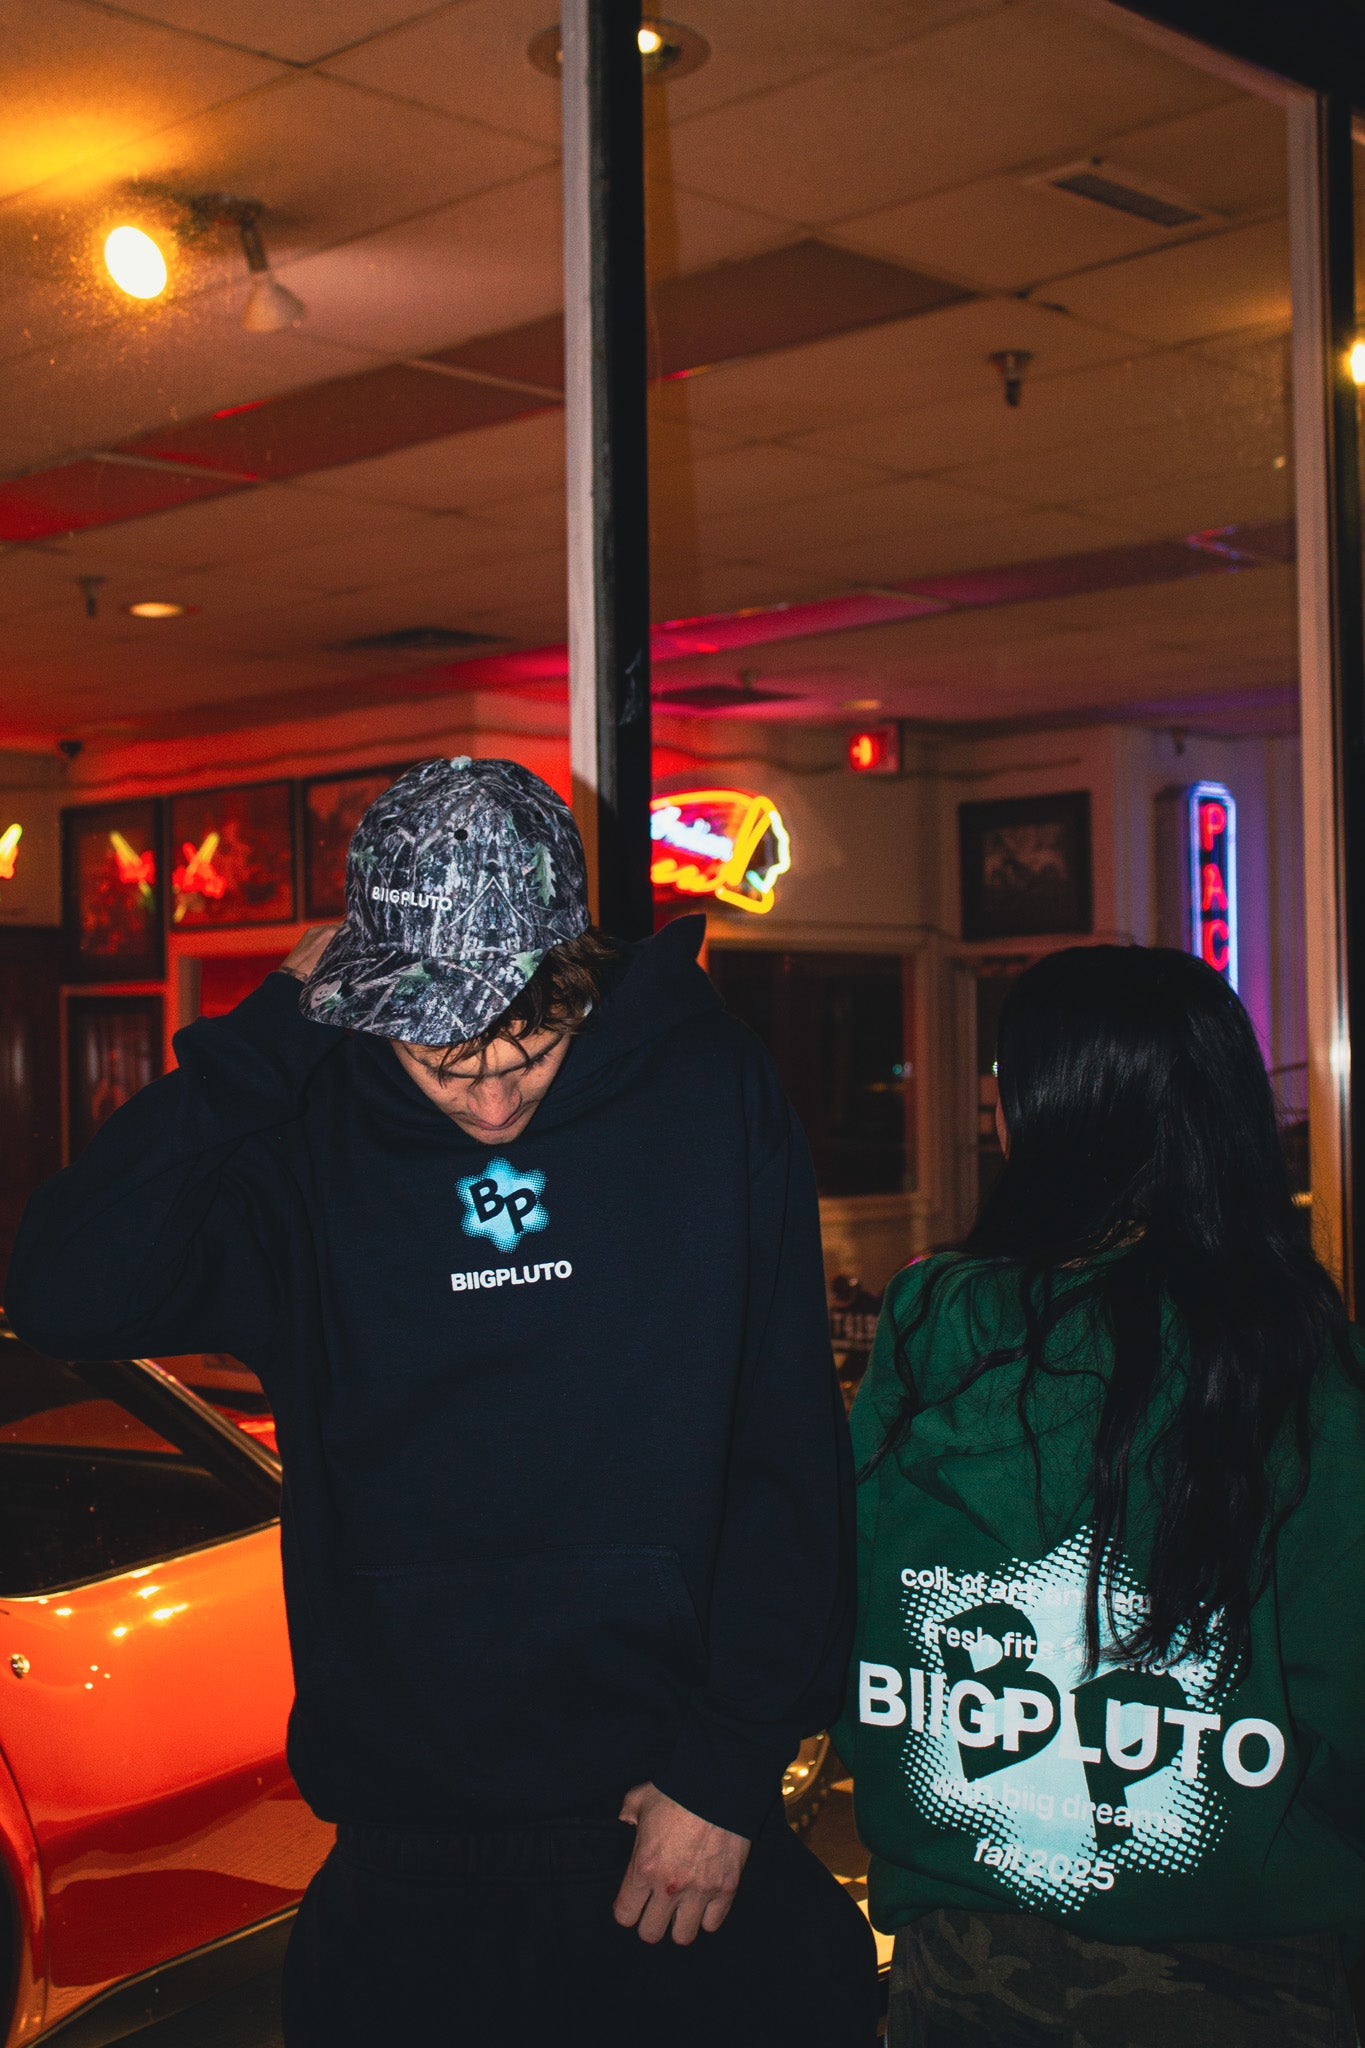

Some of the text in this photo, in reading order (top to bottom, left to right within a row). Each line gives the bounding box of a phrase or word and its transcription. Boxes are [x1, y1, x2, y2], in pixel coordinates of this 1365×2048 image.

[372, 886, 453, 911] BIIGPLUTO
[469, 1178, 537, 1234] BP
[450, 1260, 573, 1292] BIIGPLUTO
[923, 1617, 997, 1653] fresh
[1003, 1631, 1054, 1661] fits
[858, 1660, 1286, 1788] BIIGPLUTO
[1002, 1780, 1055, 1822] biig
[1061, 1792, 1183, 1838] dreams
[973, 1838, 1116, 1891] fall 2025
